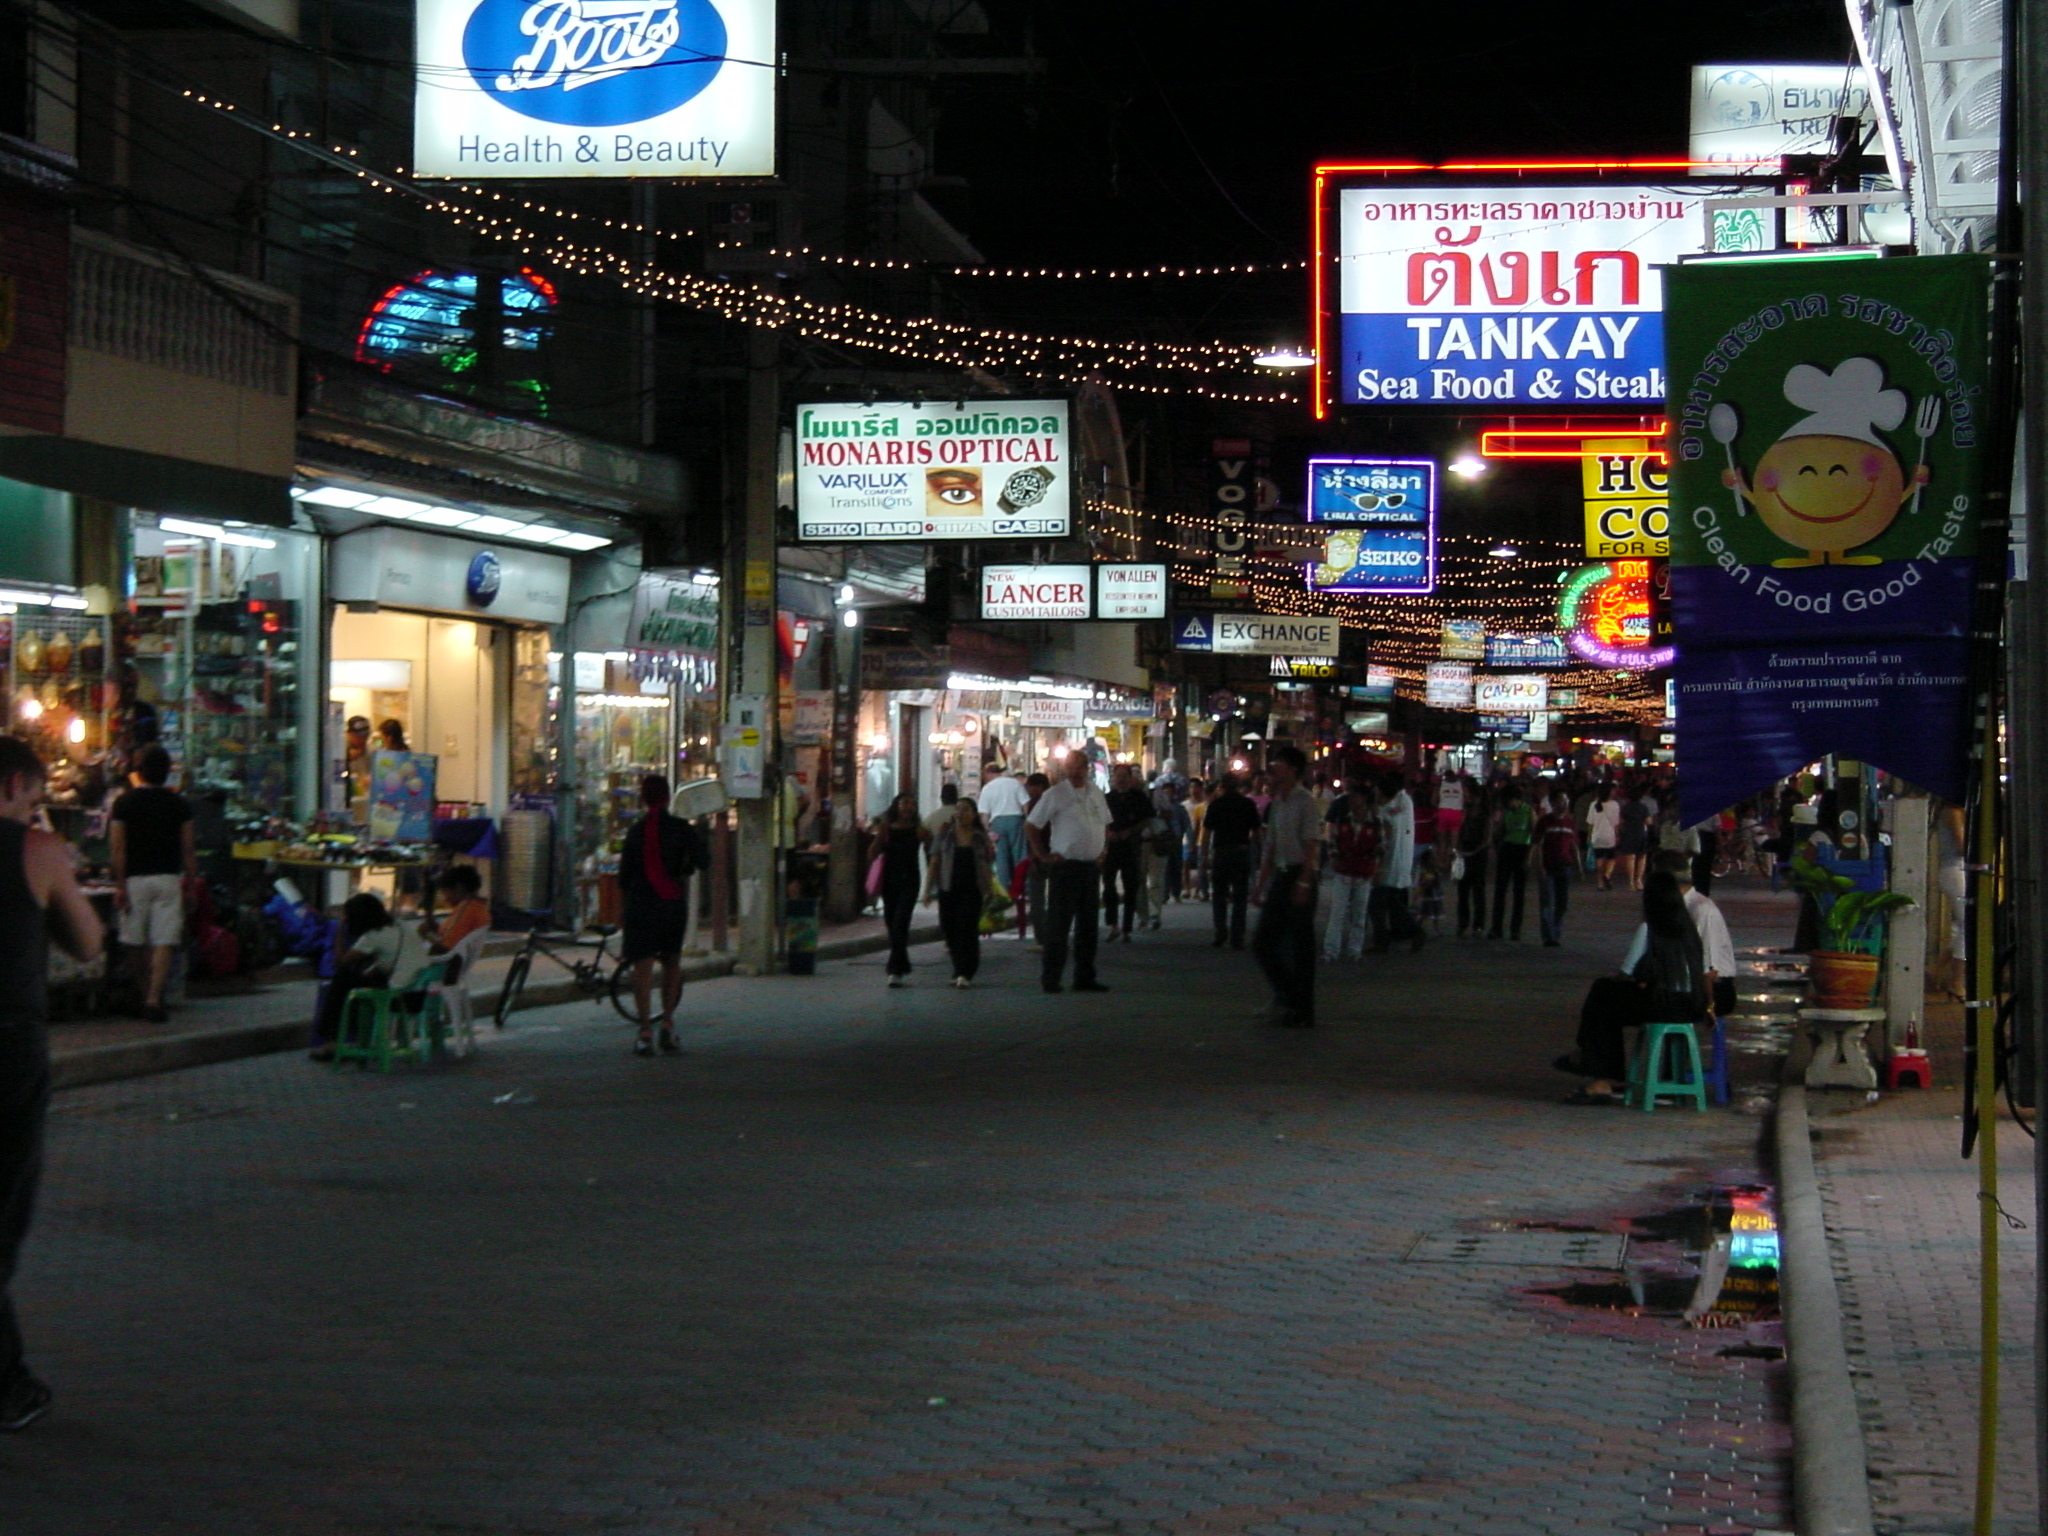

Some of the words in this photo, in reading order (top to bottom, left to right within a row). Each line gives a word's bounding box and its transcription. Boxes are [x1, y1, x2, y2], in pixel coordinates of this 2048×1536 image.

[496, 0, 681, 91] Boots
[458, 134, 563, 163] Health
[574, 135, 600, 163] &
[614, 135, 729, 168] Beauty
[1364, 194, 1684, 222] อาหารทะเลราคาชาวบ้าน
[1406, 226, 1640, 306] ตังเก
[1406, 317, 1640, 360] TANKAY
[1357, 369, 1419, 400] Sea
[1431, 367, 1515, 399] Food
[1528, 369, 1561, 399] &
[1680, 294, 1828, 461] อาหารสะอาด
[803, 440, 933, 466] MONARIS
[938, 438, 1060, 464] OPTICAL
[818, 473, 909, 490] VARILUX
[829, 496, 913, 510] Transitions
[1216, 460, 1246, 575] VOGUE
[1323, 512, 1355, 521] LIMA
[1358, 512, 1418, 521] OPTICAL
[804, 524, 860, 536] SEIKO
[865, 522, 922, 535] RADO
[934, 521, 990, 534] CITIZEN
[994, 520, 1063, 533] CASIO
[1359, 551, 1421, 566] SEIKO
[1599, 542, 1645, 555] FOR
[1692, 506, 1751, 584] Clean
[1755, 576, 1831, 614] Food
[1841, 565, 1923, 613] Good
[1917, 494, 1970, 564] Taste
[988, 573, 1016, 582] NEW
[1106, 570, 1127, 582] VON
[1127, 570, 1158, 583] ALLEN
[985, 584, 1085, 604] LANCER
[986, 606, 1034, 618] CUSTOM
[1037, 606, 1086, 617] TAILORS
[1220, 622, 1332, 642] EXCHANGE
[1032, 700, 1072, 712] VOGUE
